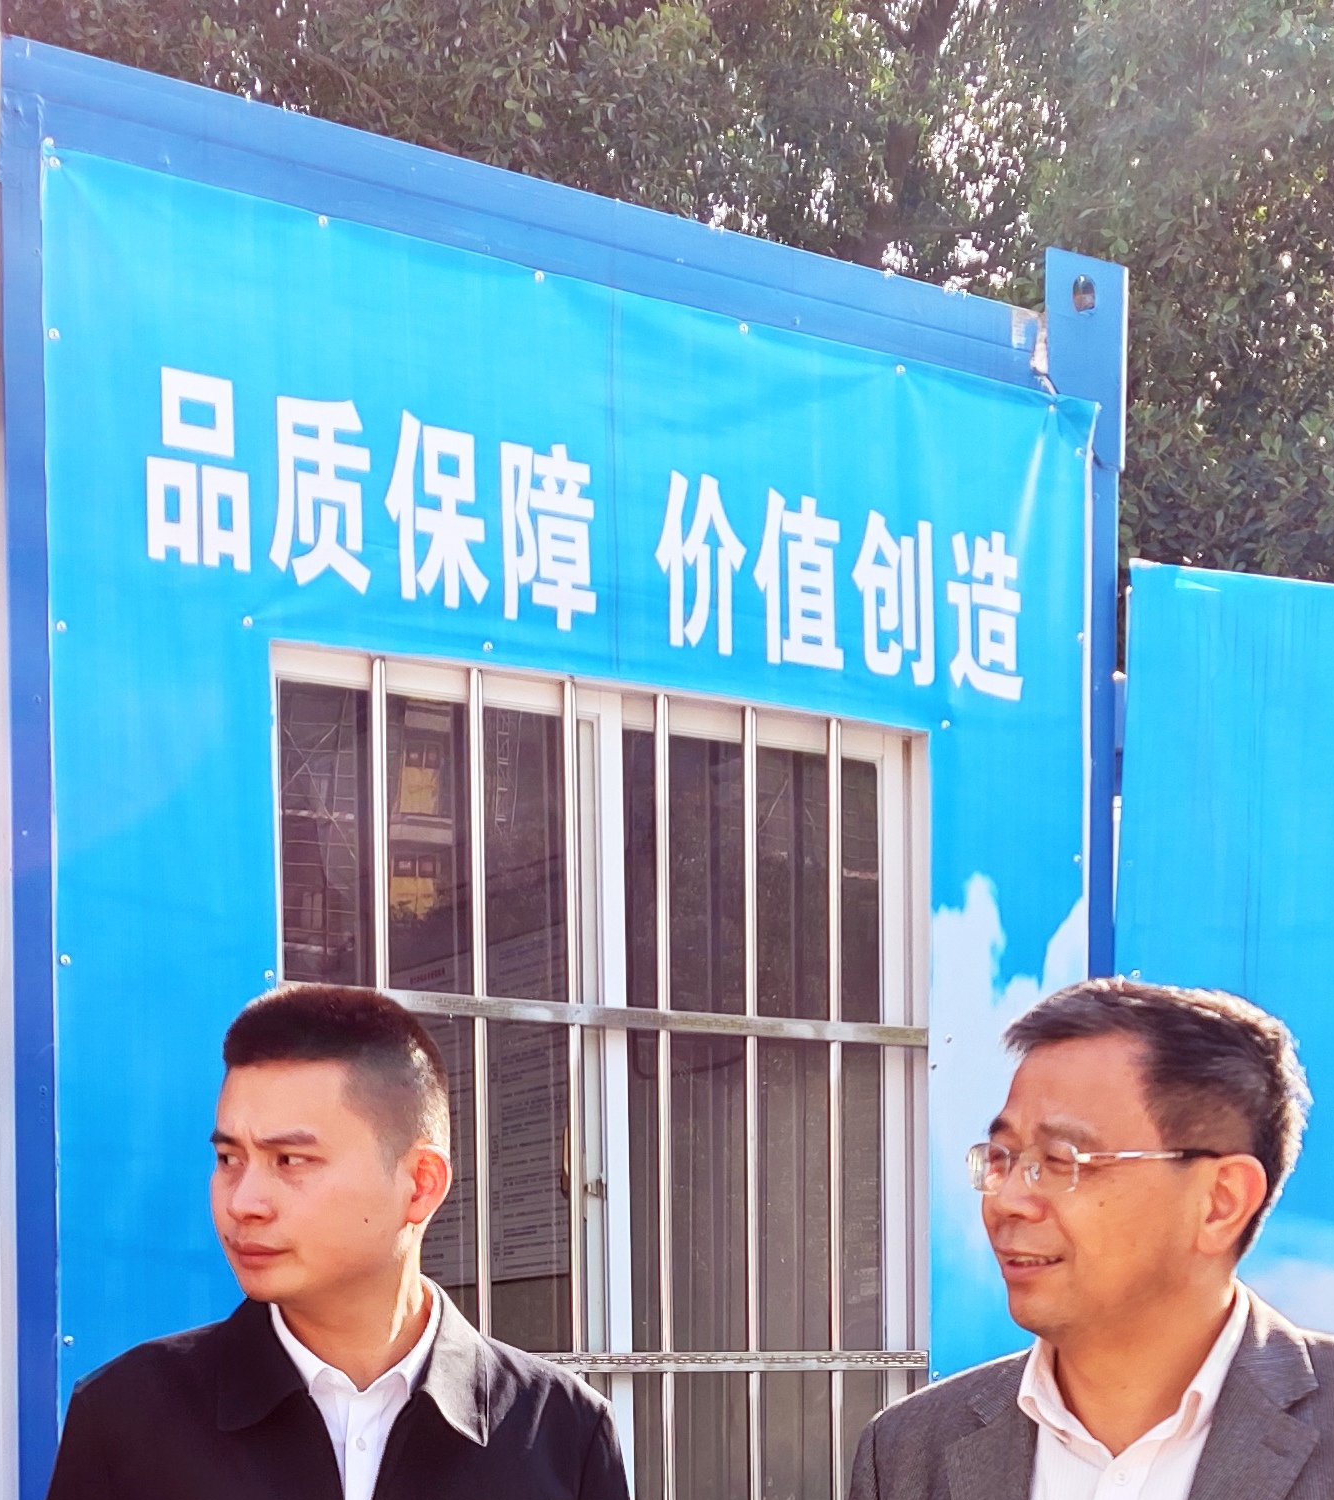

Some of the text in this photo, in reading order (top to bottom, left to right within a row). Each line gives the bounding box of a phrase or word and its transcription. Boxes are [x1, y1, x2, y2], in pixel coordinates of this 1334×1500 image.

[146, 365, 1024, 702] 品质保障 价值创造
